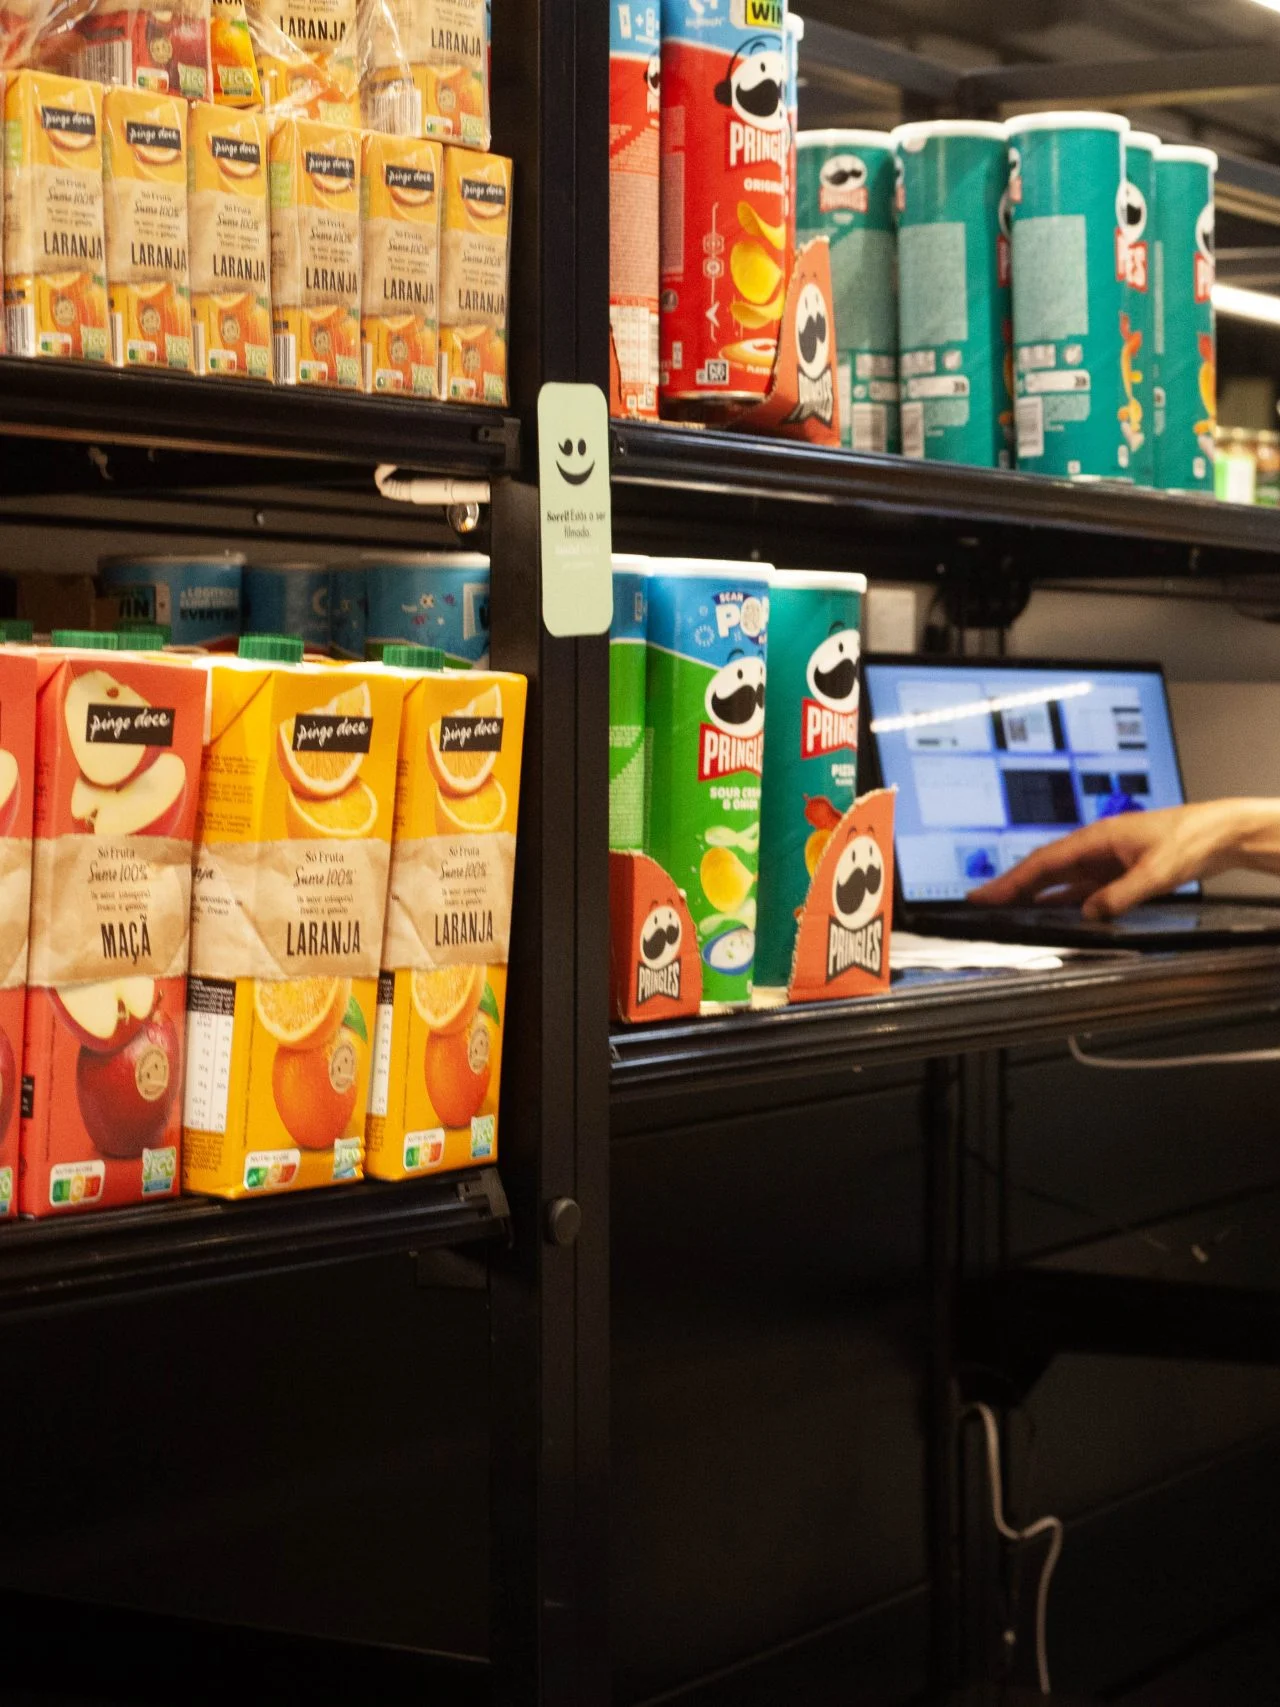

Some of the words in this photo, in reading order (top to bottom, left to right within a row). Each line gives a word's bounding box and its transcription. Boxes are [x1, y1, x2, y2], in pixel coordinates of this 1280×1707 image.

[280, 14, 346, 41] LARANJA
[431, 27, 482, 58] LARANJA
[44, 231, 103, 260] LARANJA
[131, 240, 187, 272] LARANJA
[213, 254, 266, 283] LARANJA
[306, 267, 358, 294] LARANJA
[384, 278, 434, 304] LARANJA
[458, 290, 505, 316] LARANJA
[90, 713, 131, 742] pingo
[134, 708, 170, 729] doce
[297, 722, 333, 750] pingo
[337, 717, 368, 736] doce
[443, 722, 472, 749] pingo
[474, 719, 499, 736] doce
[709, 786, 740, 799] SOUR
[88, 860, 117, 884] Sumo
[293, 865, 324, 888] Sumo
[101, 914, 151, 964] MAÇÃ
[287, 920, 361, 956] LARANJA
[435, 910, 493, 946] LARANJA
[828, 919, 882, 976] PRINGLES
[638, 961, 680, 1002] PRINGLES
